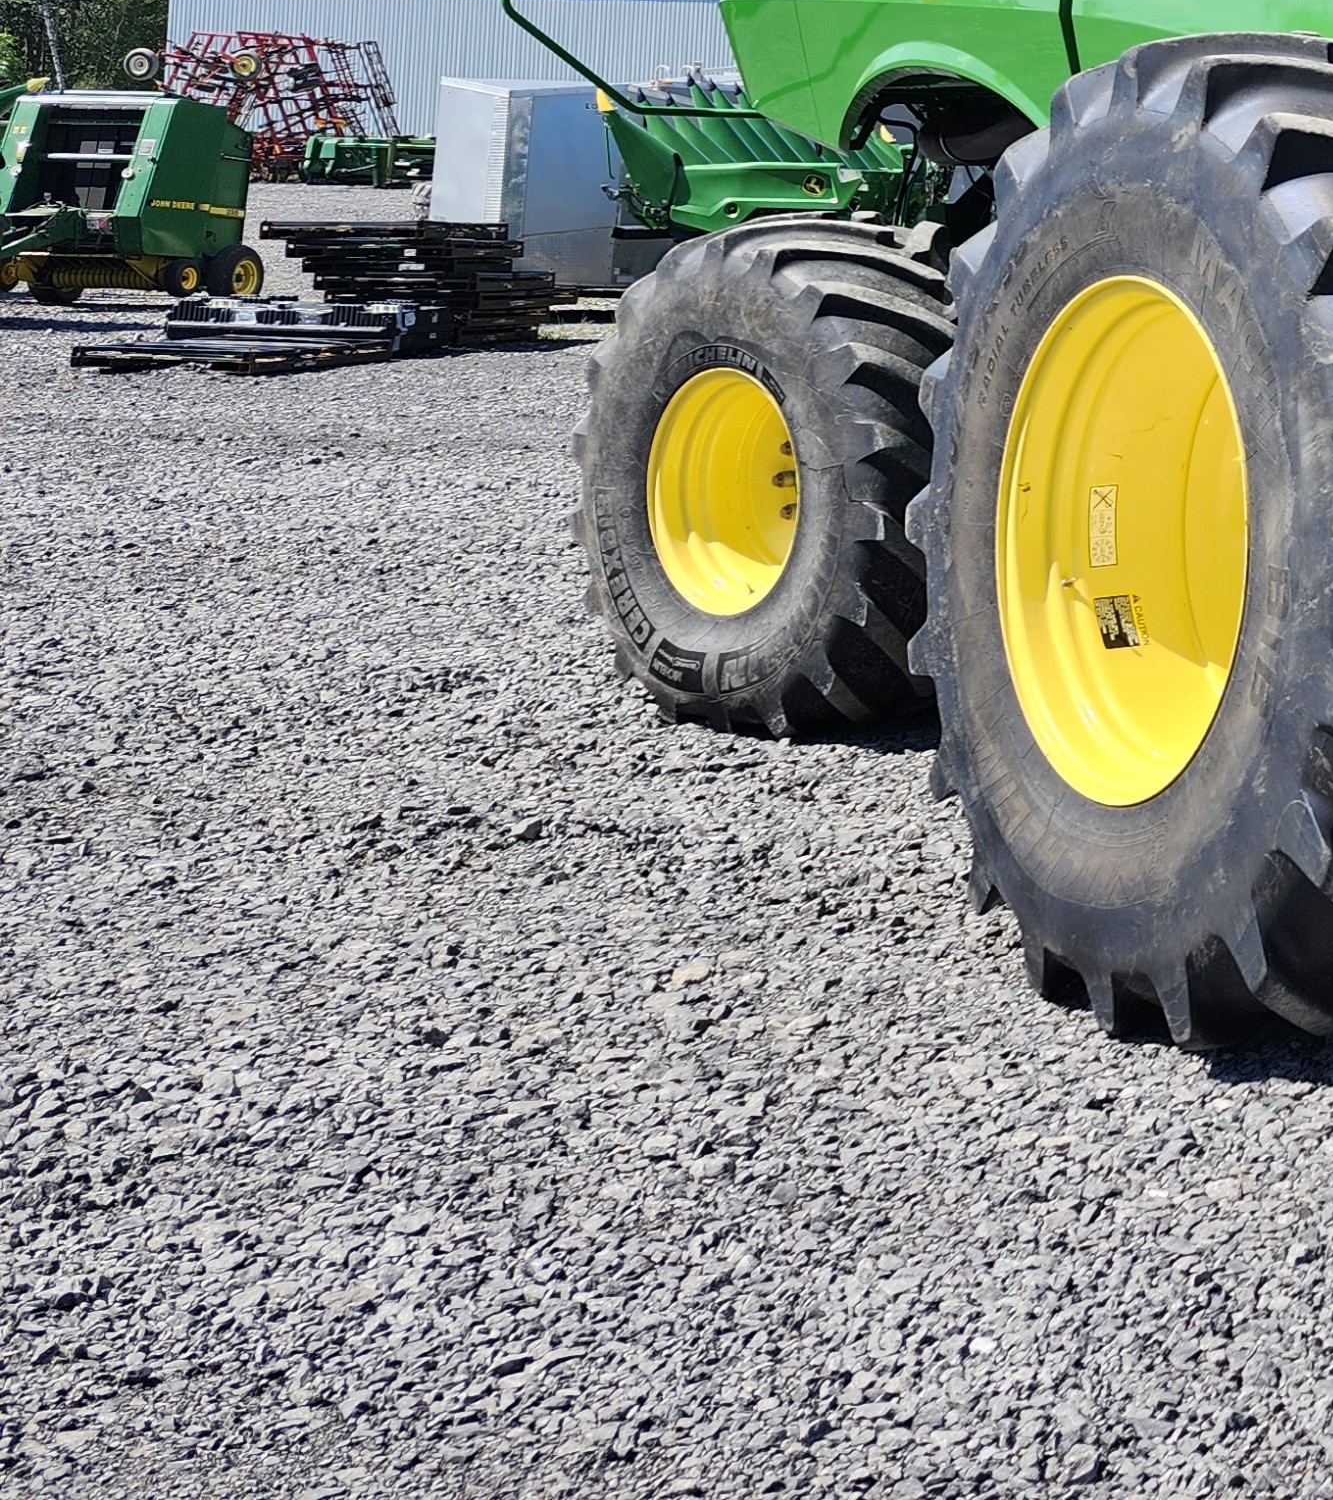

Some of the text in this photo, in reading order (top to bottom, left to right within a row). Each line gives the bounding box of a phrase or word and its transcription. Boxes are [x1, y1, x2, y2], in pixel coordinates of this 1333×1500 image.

[978, 235, 1070, 409] RADIAL TUBELESS
[1134, 606, 1152, 646] CAUTION
